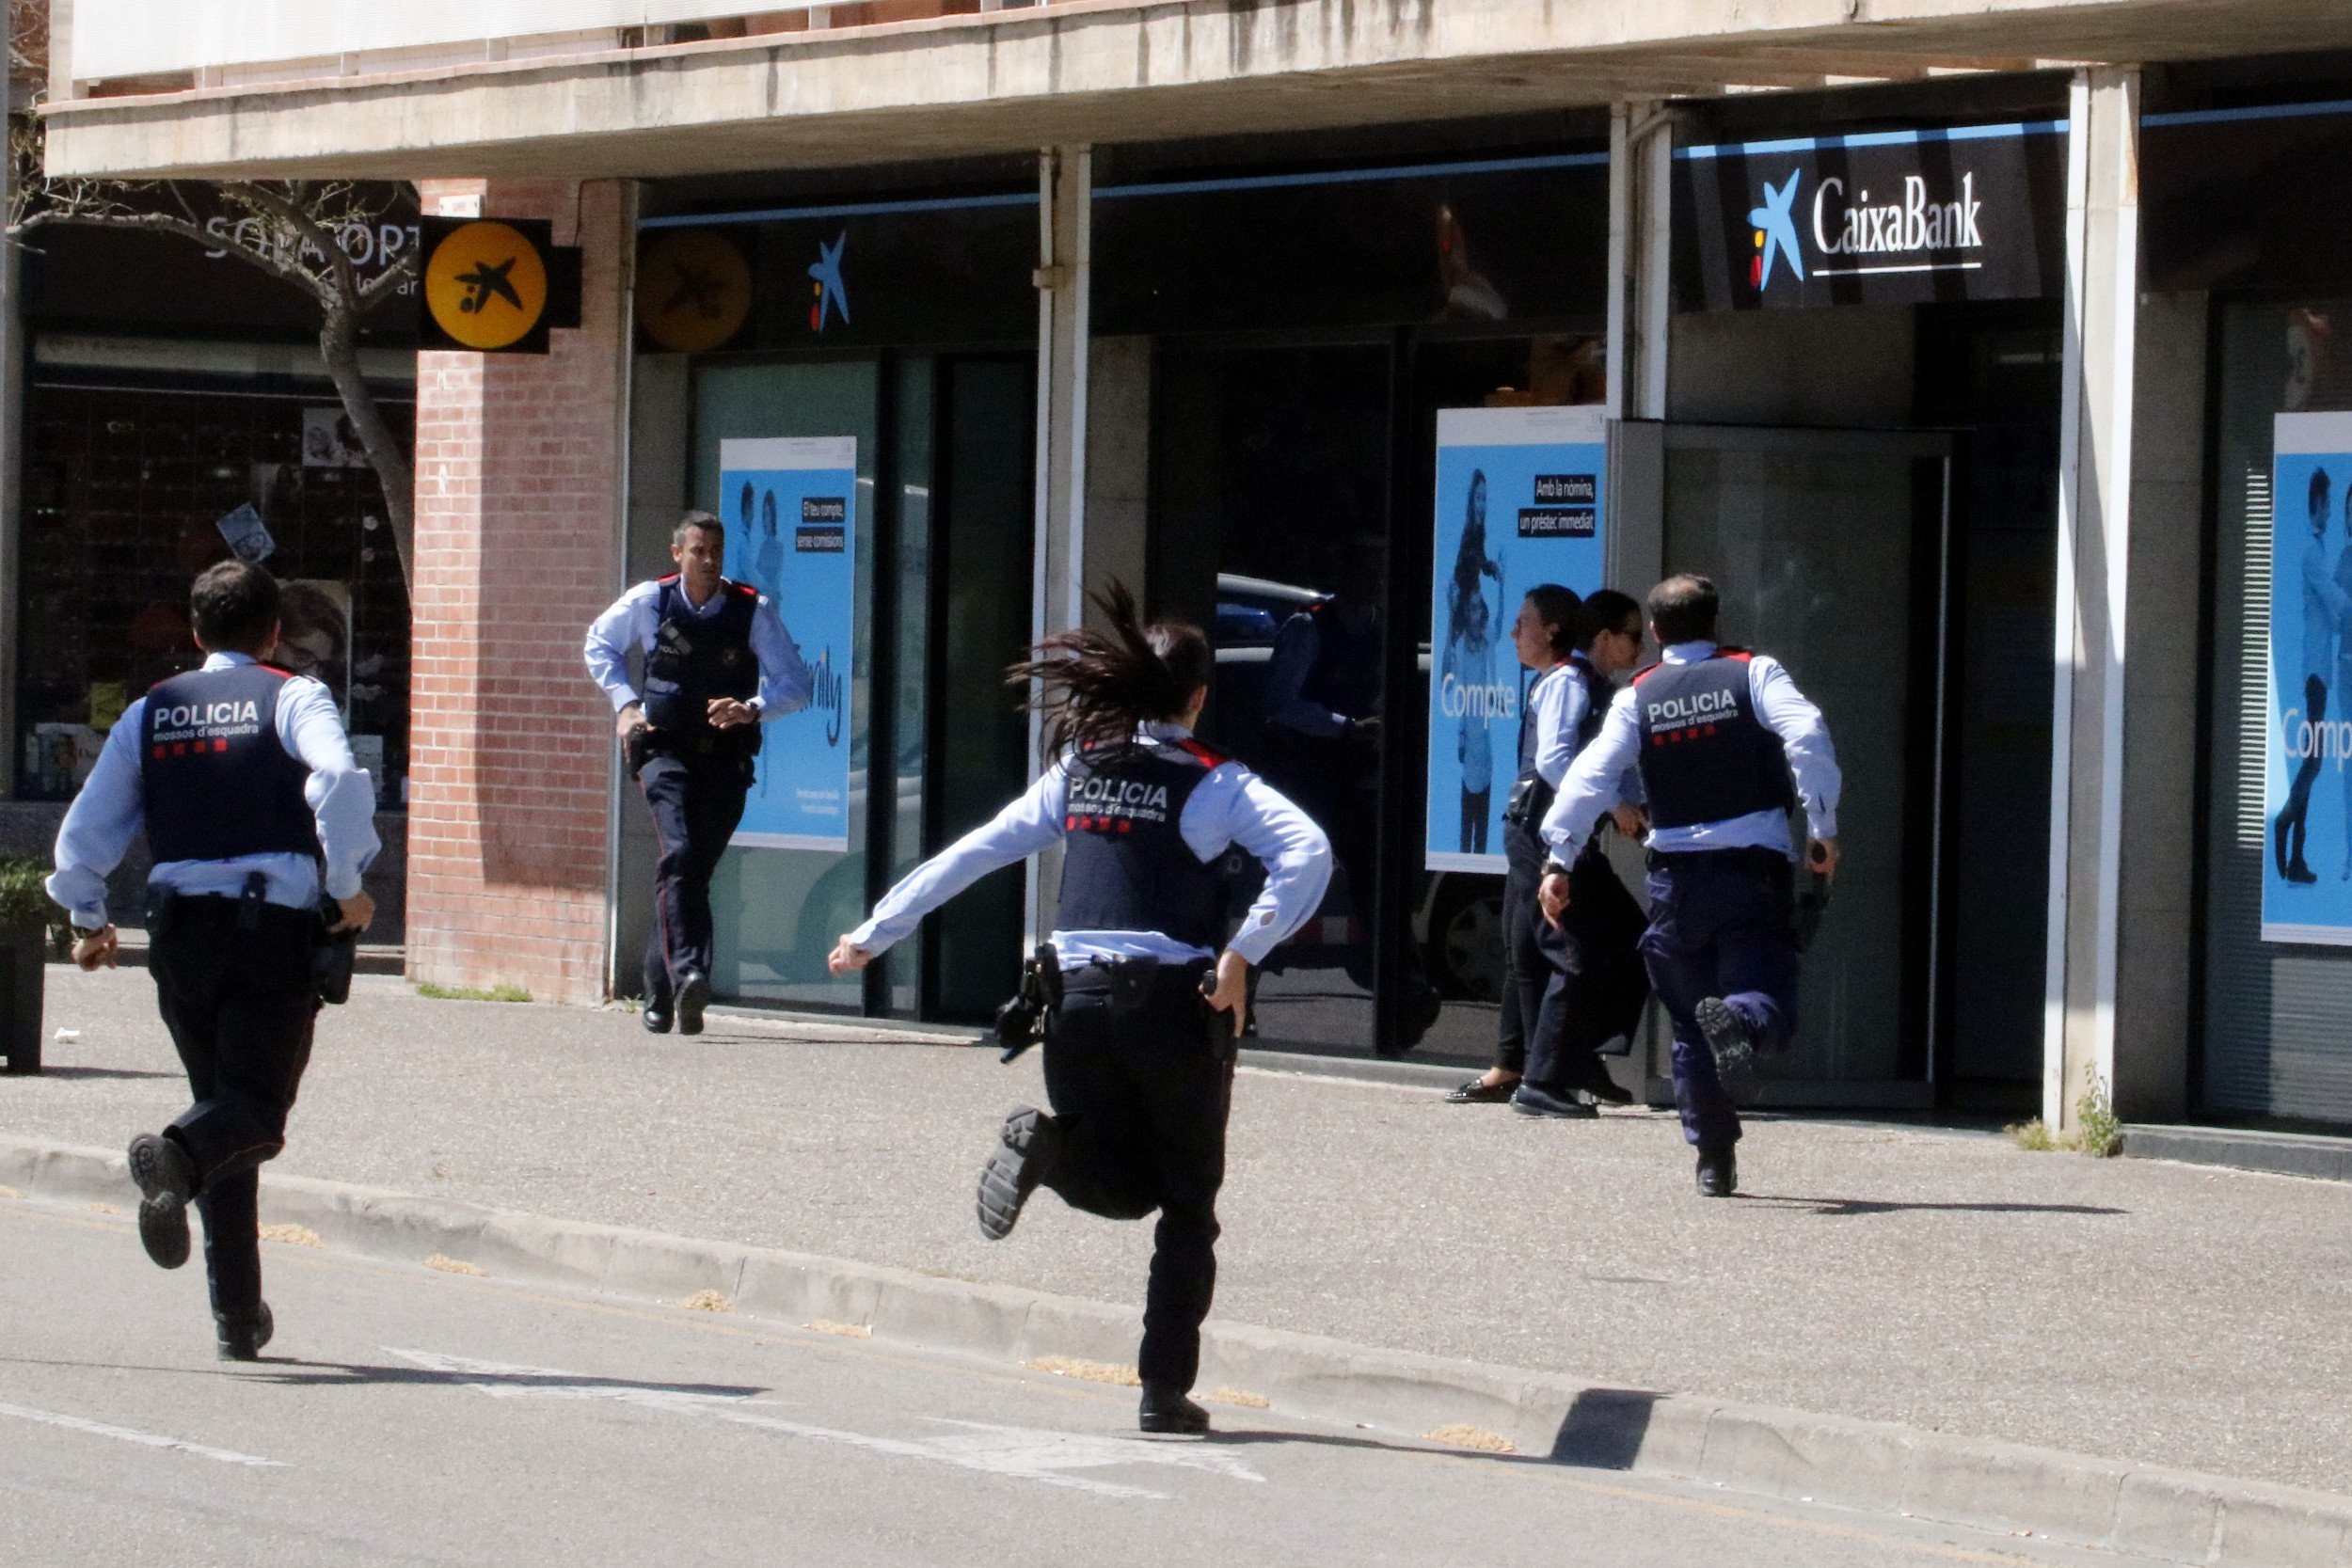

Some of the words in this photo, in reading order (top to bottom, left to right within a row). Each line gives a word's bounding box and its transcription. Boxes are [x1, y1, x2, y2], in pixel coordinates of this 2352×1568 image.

[1813, 171, 1982, 254] CaixaBank
[1536, 479, 1555, 498] Amb
[1555, 479, 1563, 498] la
[1519, 516, 1531, 530] un
[153, 700, 259, 730] POLICIA
[1441, 673, 1516, 730] Compte
[1647, 689, 1737, 723] POLICIA
[152, 729, 196, 742] mossos
[196, 723, 260, 737] d'esquadra
[1069, 776, 1167, 809] POLICIA
